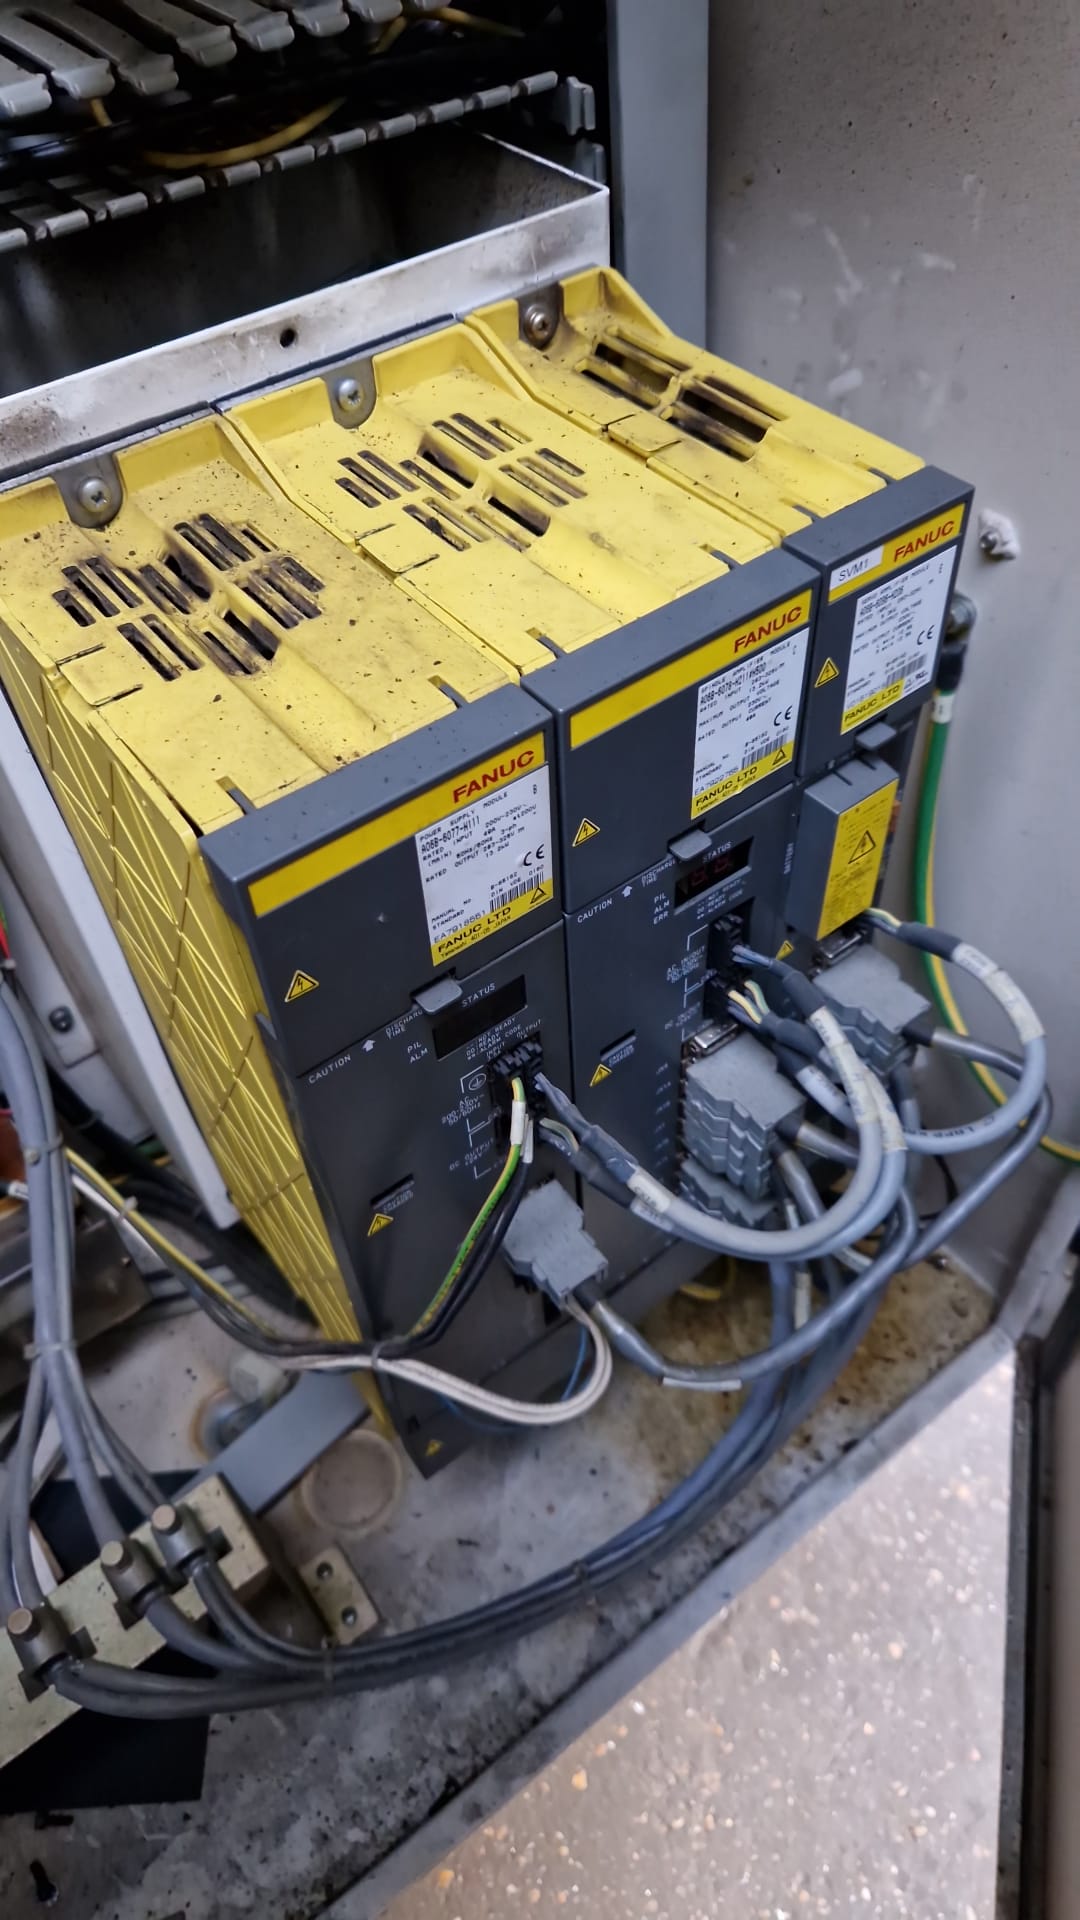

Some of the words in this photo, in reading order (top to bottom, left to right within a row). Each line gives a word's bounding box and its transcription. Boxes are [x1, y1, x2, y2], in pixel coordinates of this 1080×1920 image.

[894, 520, 954, 562] FANUC
[839, 559, 868, 581] SVM1
[734, 606, 801, 653] FANUC
[844, 699, 877, 722] FANUC
[882, 685, 901, 701] LTD
[453, 750, 534, 803] FANUC
[696, 779, 733, 807] FANUC
[737, 765, 757, 783] LTD
[419, 826, 441, 842] POWER
[450, 808, 474, 826] SUPPLY
[483, 791, 507, 808] MODULE
[422, 845, 444, 861] RATED
[453, 830, 472, 845] INPUT
[523, 844, 544, 868] CE
[703, 841, 732, 862] STATUS
[425, 867, 447, 883] RATED
[454, 850, 479, 868] OUTPUT
[641, 858, 676, 882] DISCHARG
[653, 892, 667, 904] PIL
[653, 900, 670, 915] ALM
[431, 906, 454, 923] MANUAL
[432, 908, 464, 930] STANDARD
[577, 898, 613, 924] CAUTION
[653, 912, 670, 925] ERR
[438, 923, 481, 952] FANUC
[487, 905, 511, 924] LTD
[461, 982, 496, 1008] STATUS
[386, 1010, 423, 1033] DISCHARG
[406, 1041, 422, 1054] PIL
[409, 1047, 428, 1064] ALM
[308, 1055, 351, 1084] CAUTION
